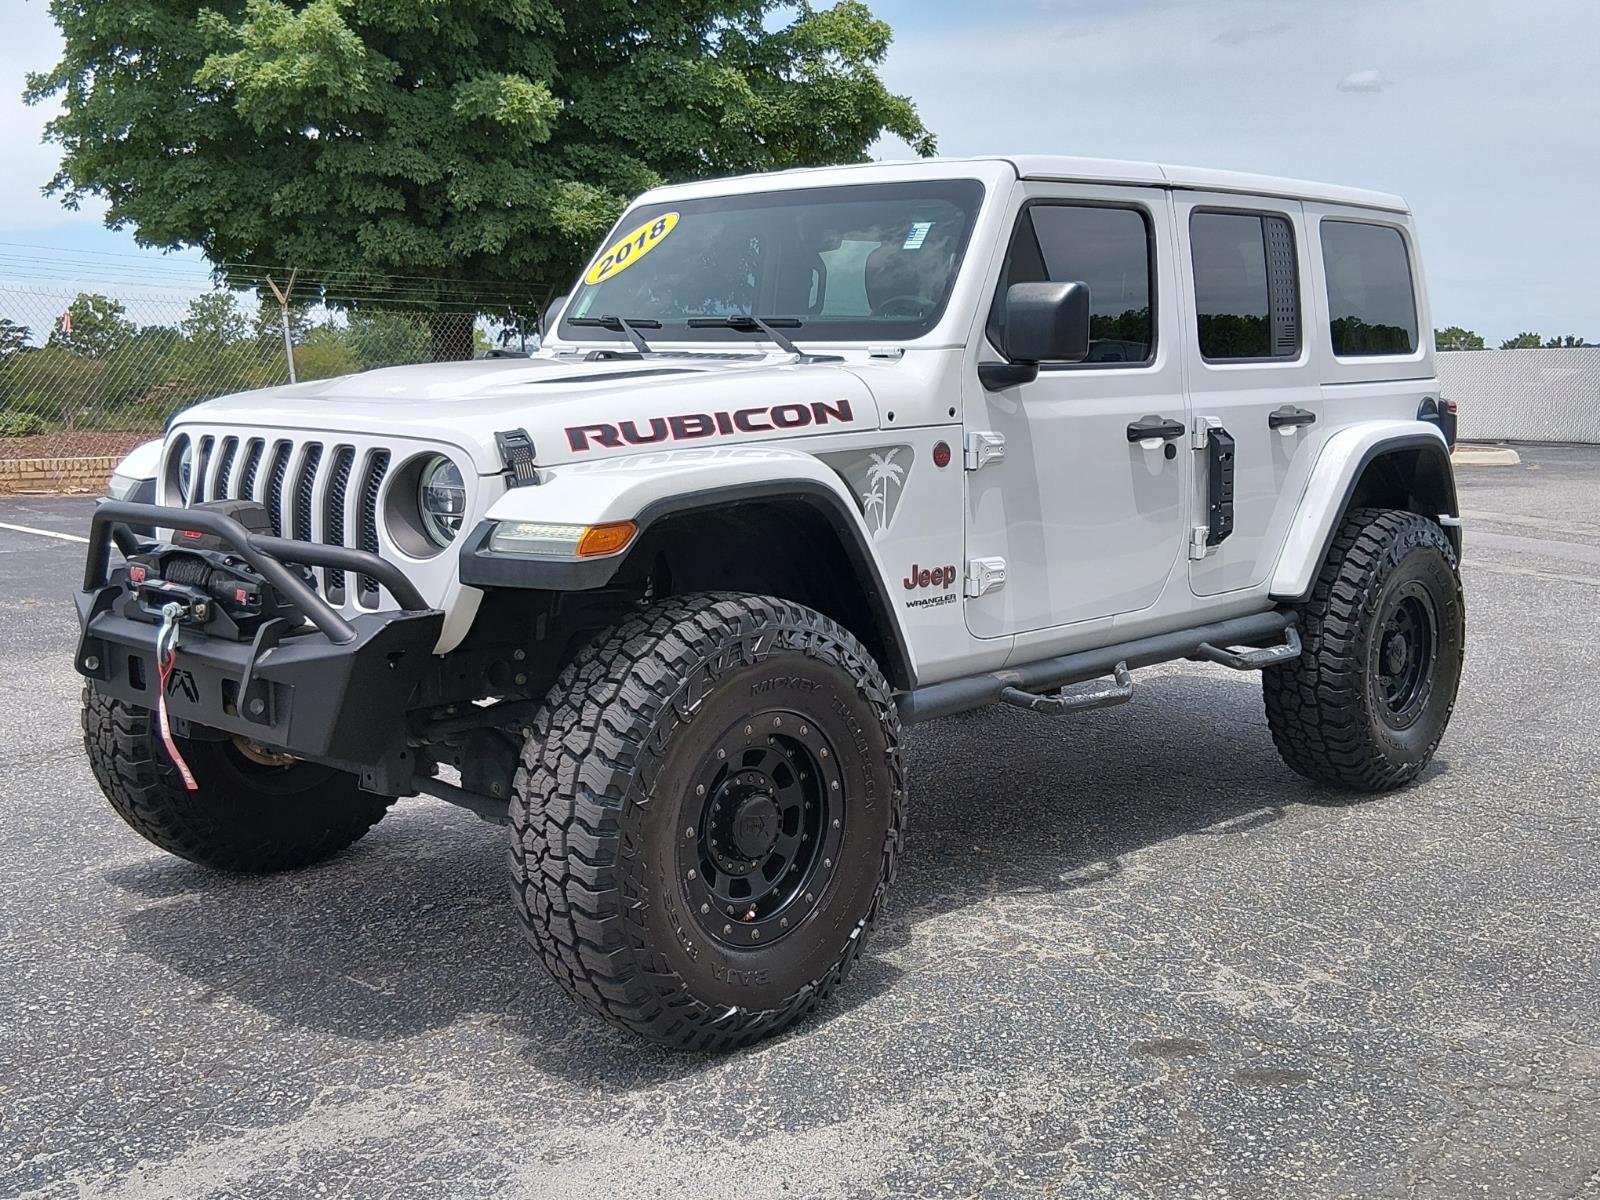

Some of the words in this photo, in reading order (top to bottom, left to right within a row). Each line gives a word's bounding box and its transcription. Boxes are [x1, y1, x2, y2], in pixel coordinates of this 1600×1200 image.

[597, 218, 666, 280] 2018
[564, 399, 854, 453] RUBICON
[903, 564, 957, 590] Jeep
[905, 593, 957, 608] WRANGLER
[751, 677, 823, 697] MICKEY
